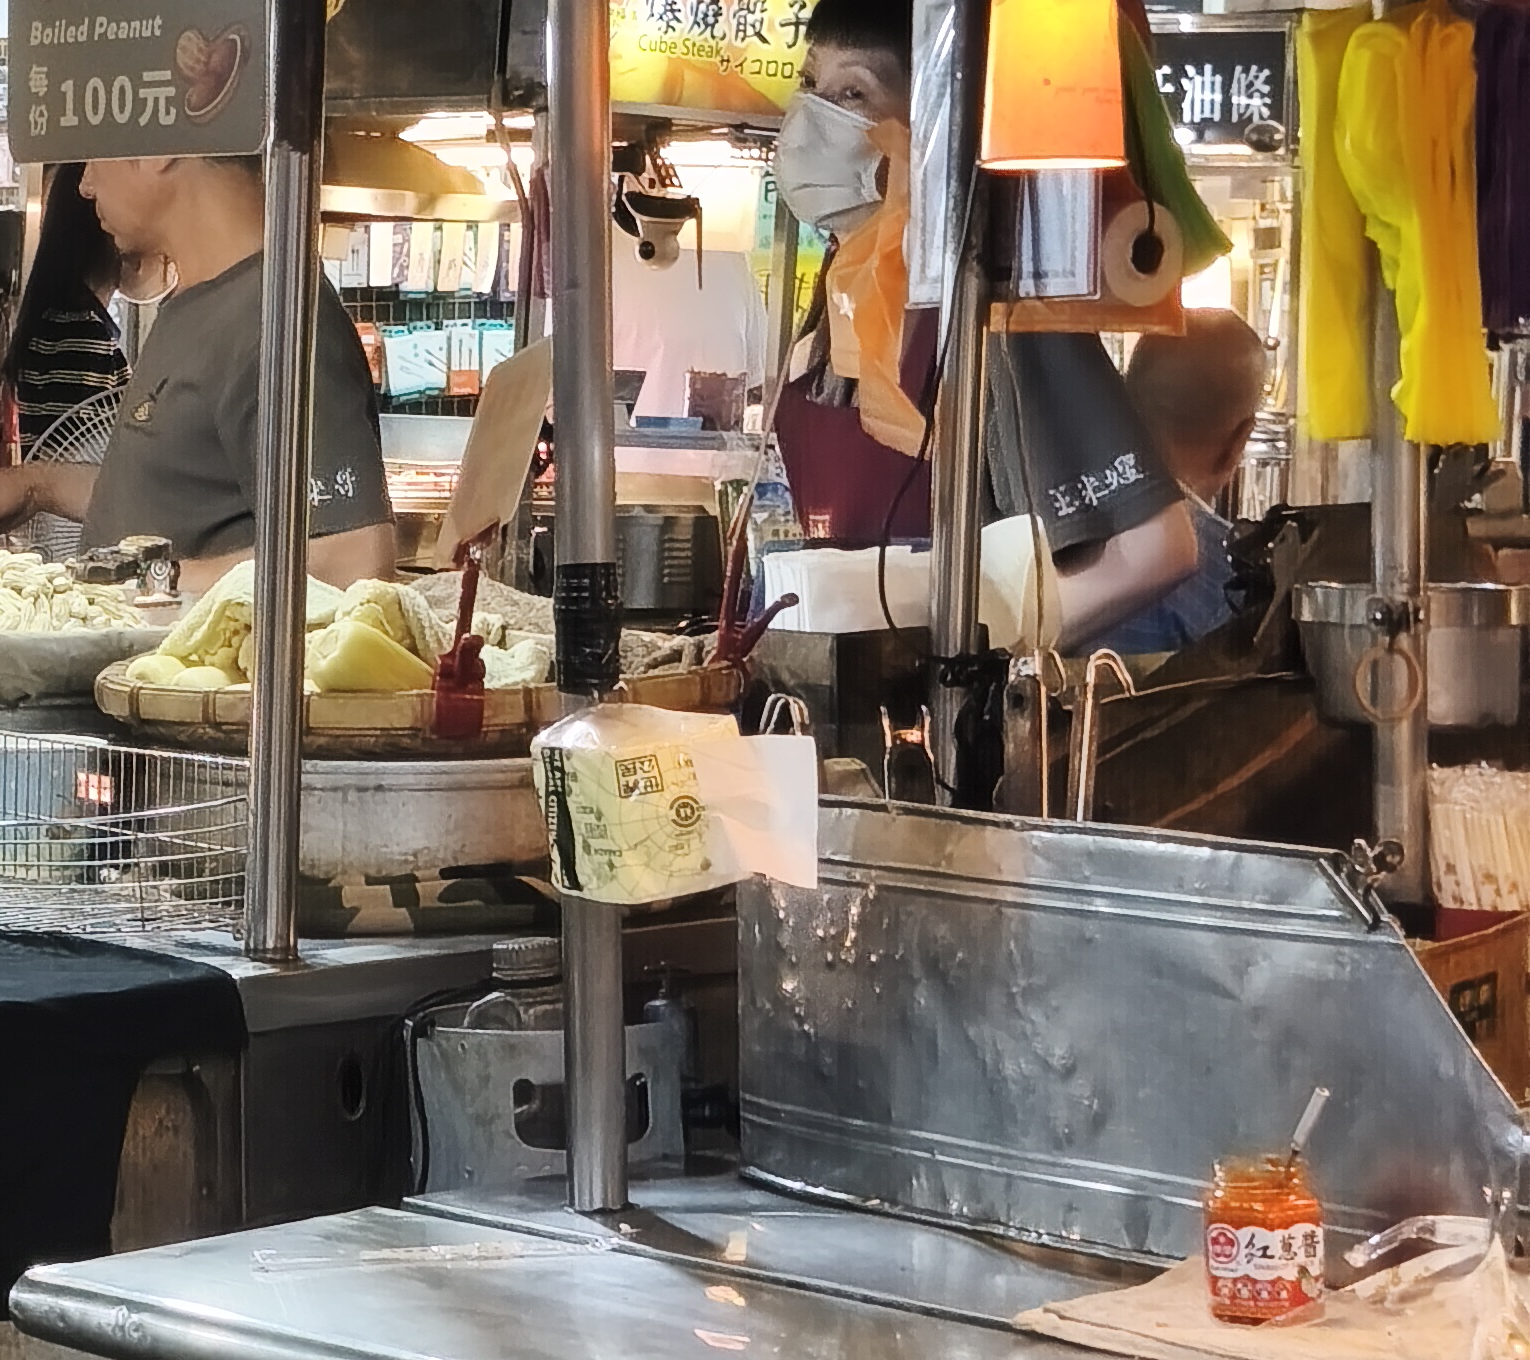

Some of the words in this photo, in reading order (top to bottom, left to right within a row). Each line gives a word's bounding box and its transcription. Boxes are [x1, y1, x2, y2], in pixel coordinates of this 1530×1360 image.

[30, 16, 88, 45] Boiled
[94, 15, 163, 40] Peanut
[638, 34, 678, 55] Cube
[681, 39, 724, 58] Steak
[719, 56, 801, 80] サイコロロ
[29, 64, 48, 137] 每份
[60, 70, 176, 127] 100元
[1155, 63, 1272, 125] 油條
